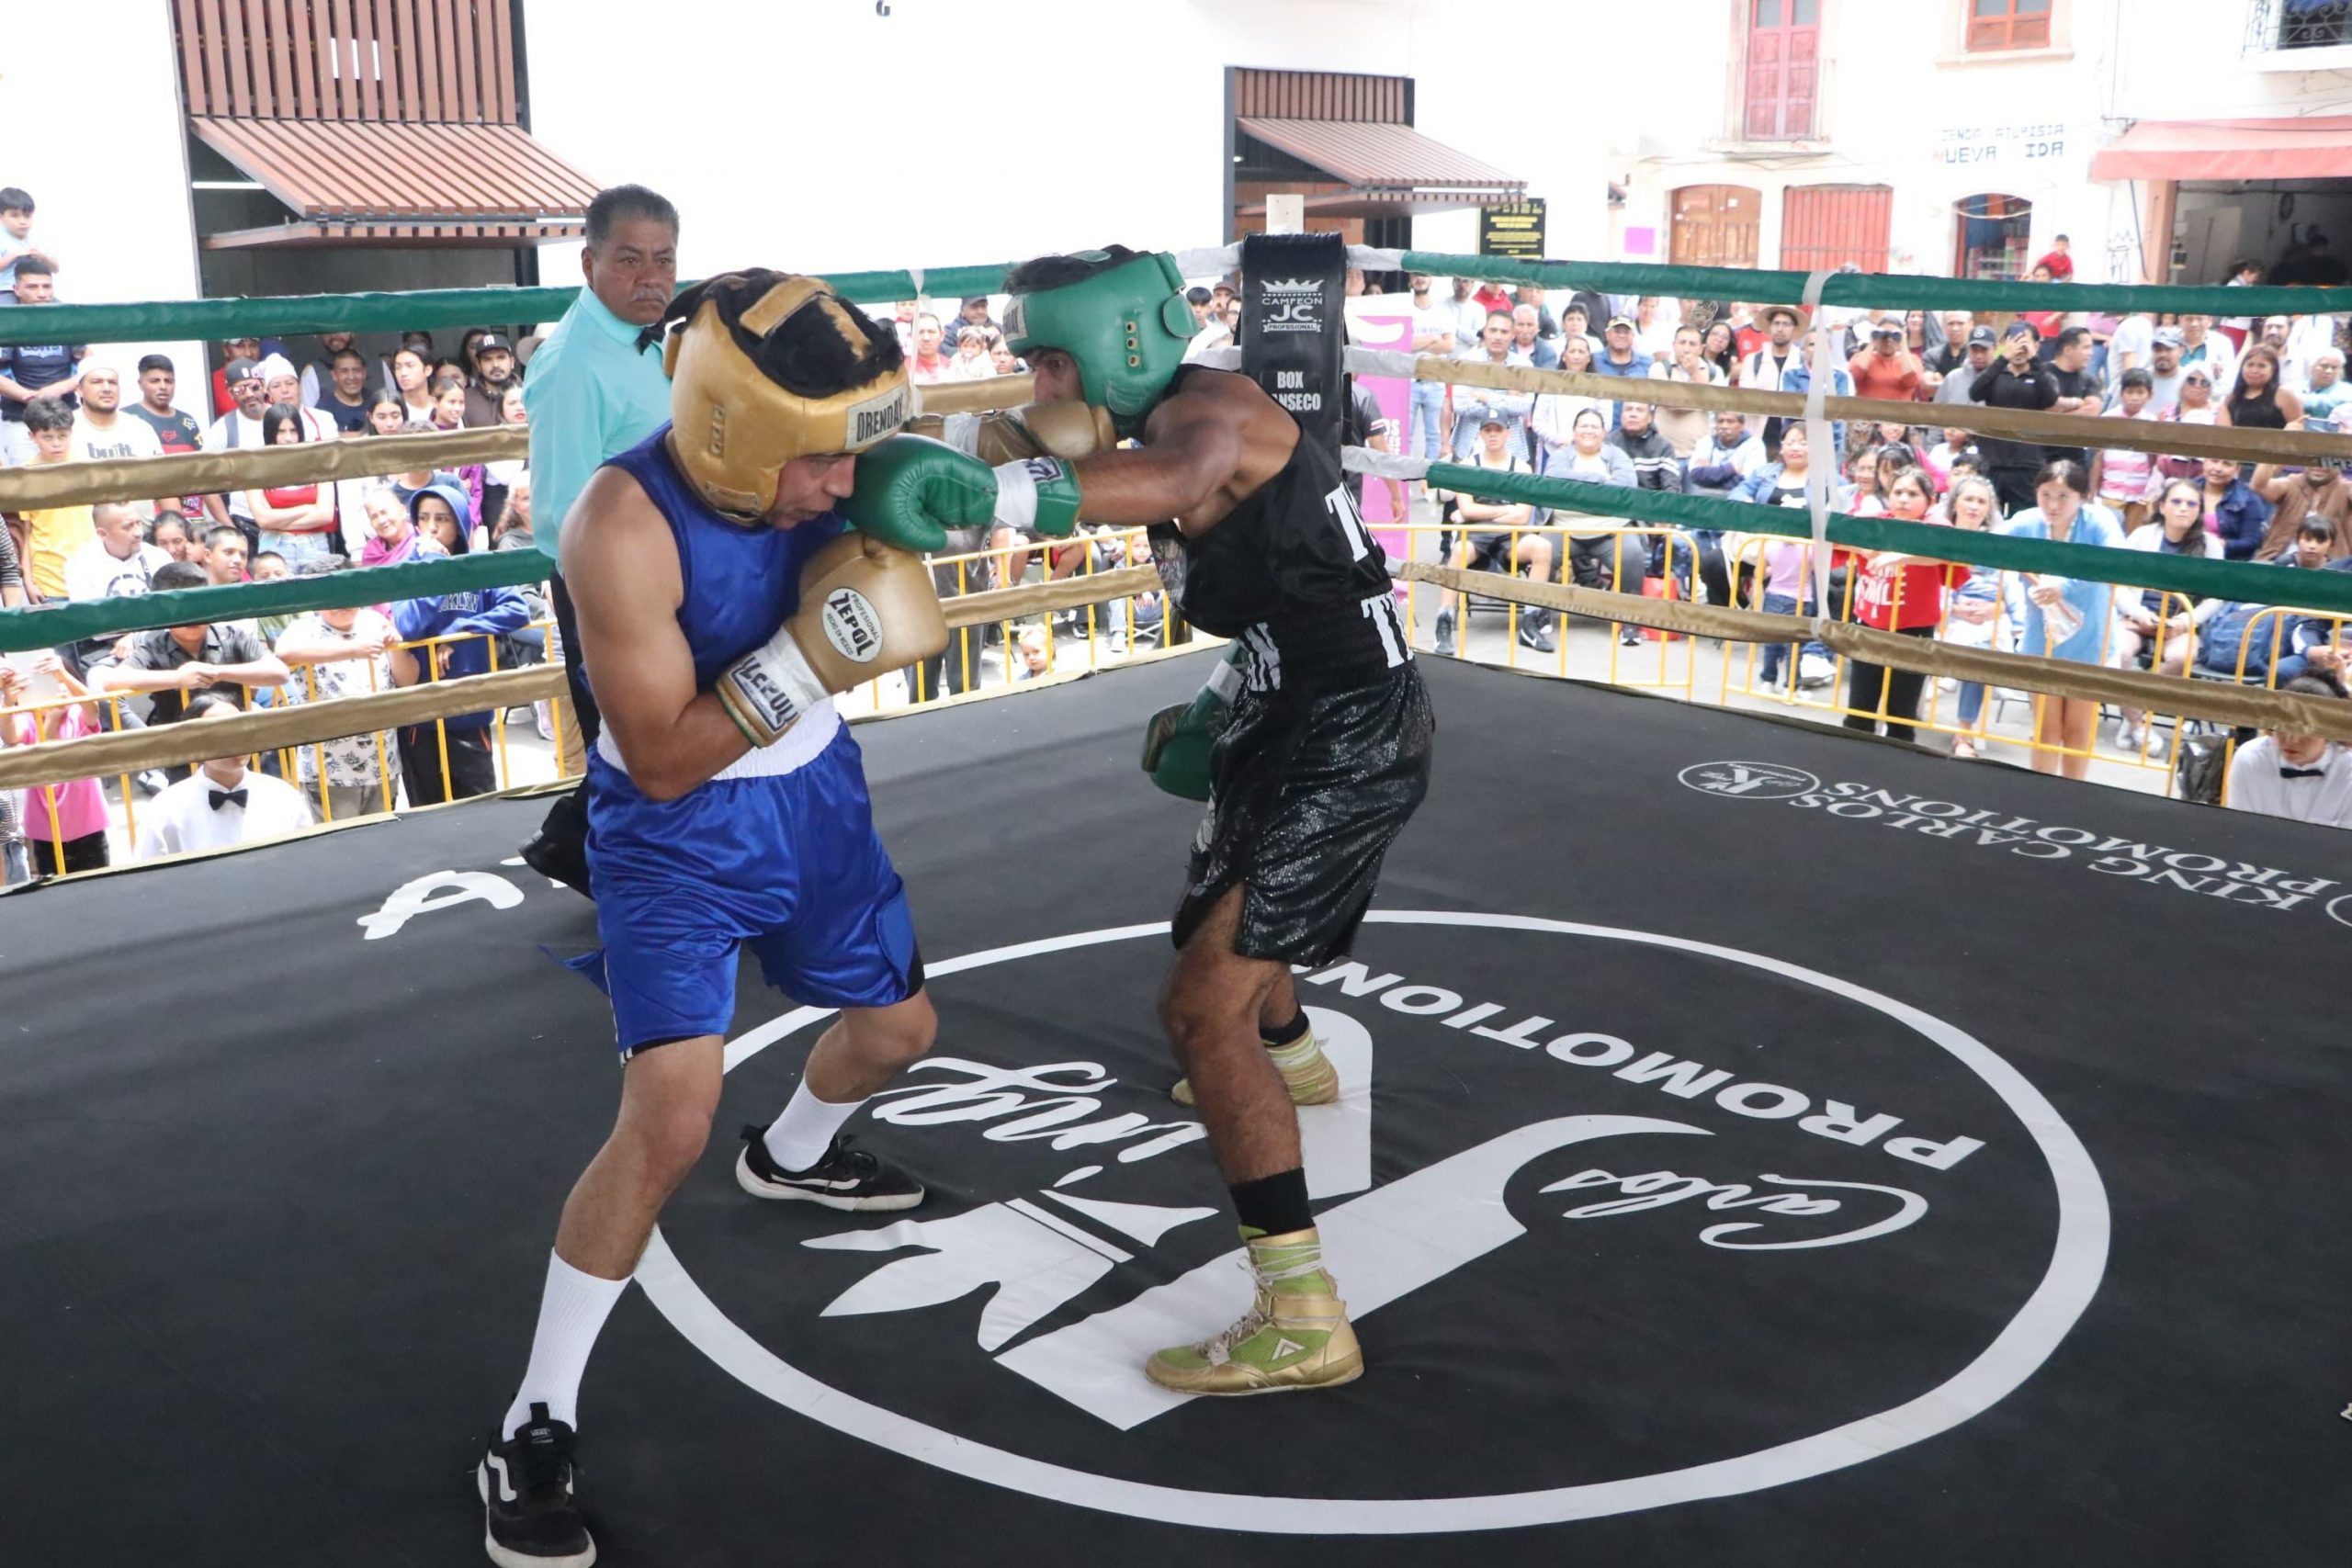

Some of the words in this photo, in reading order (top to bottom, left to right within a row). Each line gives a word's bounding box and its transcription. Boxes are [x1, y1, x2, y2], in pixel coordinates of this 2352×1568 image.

[1270, 304, 1314, 321] JC
[1272, 393, 1321, 411] NSECO
[1277, 371, 1304, 389] BOX
[856, 393, 903, 443] ORENDAY
[829, 592, 876, 657] ZEPOL
[851, 593, 880, 640] PROFESIONAL
[1789, 794, 2072, 859] CARLOS
[1823, 782, 2342, 896] PROMOTIONS
[2087, 856, 2314, 910] KING
[1290, 960, 1986, 1171] PROMOTION
[856, 1056, 1209, 1187] ing
